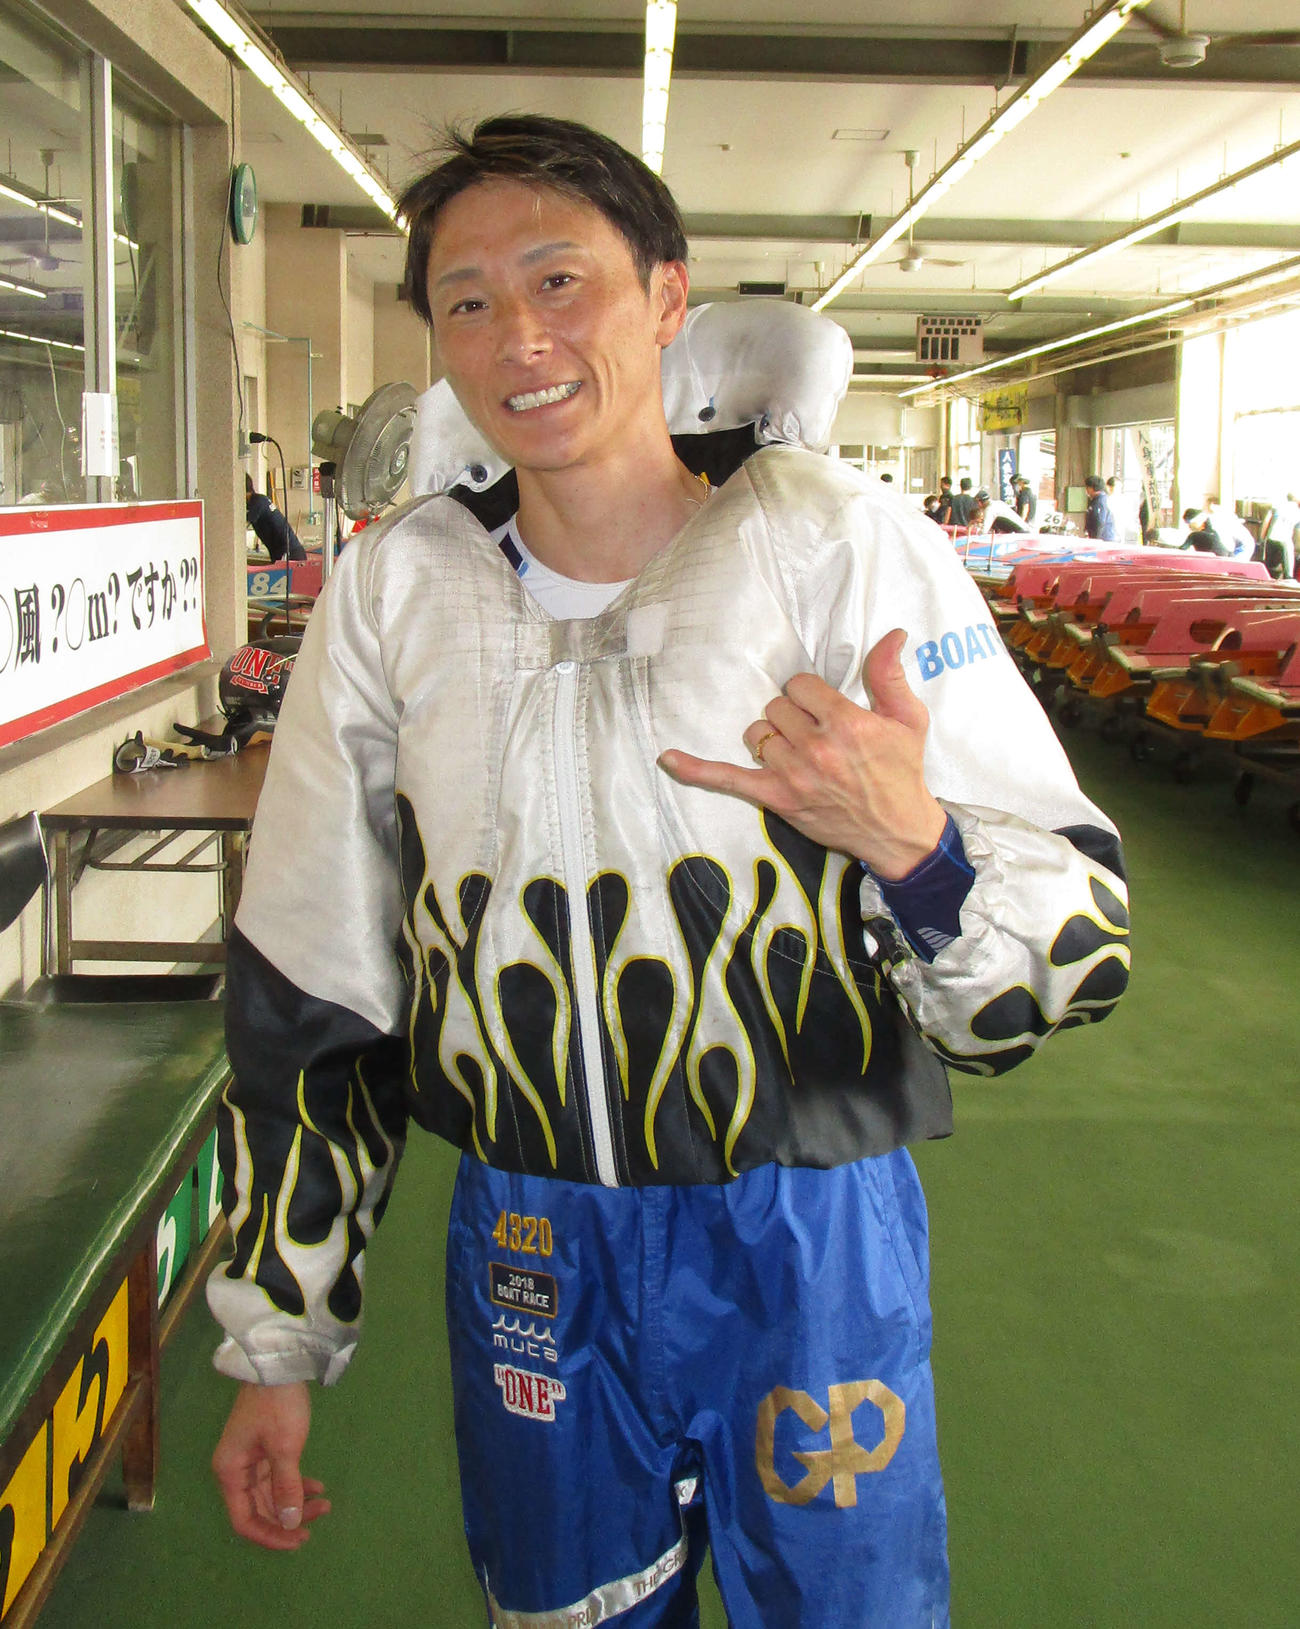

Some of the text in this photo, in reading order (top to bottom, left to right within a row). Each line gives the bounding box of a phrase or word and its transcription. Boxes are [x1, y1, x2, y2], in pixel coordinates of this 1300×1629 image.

[250, 572, 288, 596] 84
[916, 623, 1006, 682] BOAT
[492, 1209, 554, 1257] 4320
[497, 1283, 550, 1308] BOAT RACE
[508, 1273, 535, 1290] 2018
[755, 1378, 906, 1509] GP
